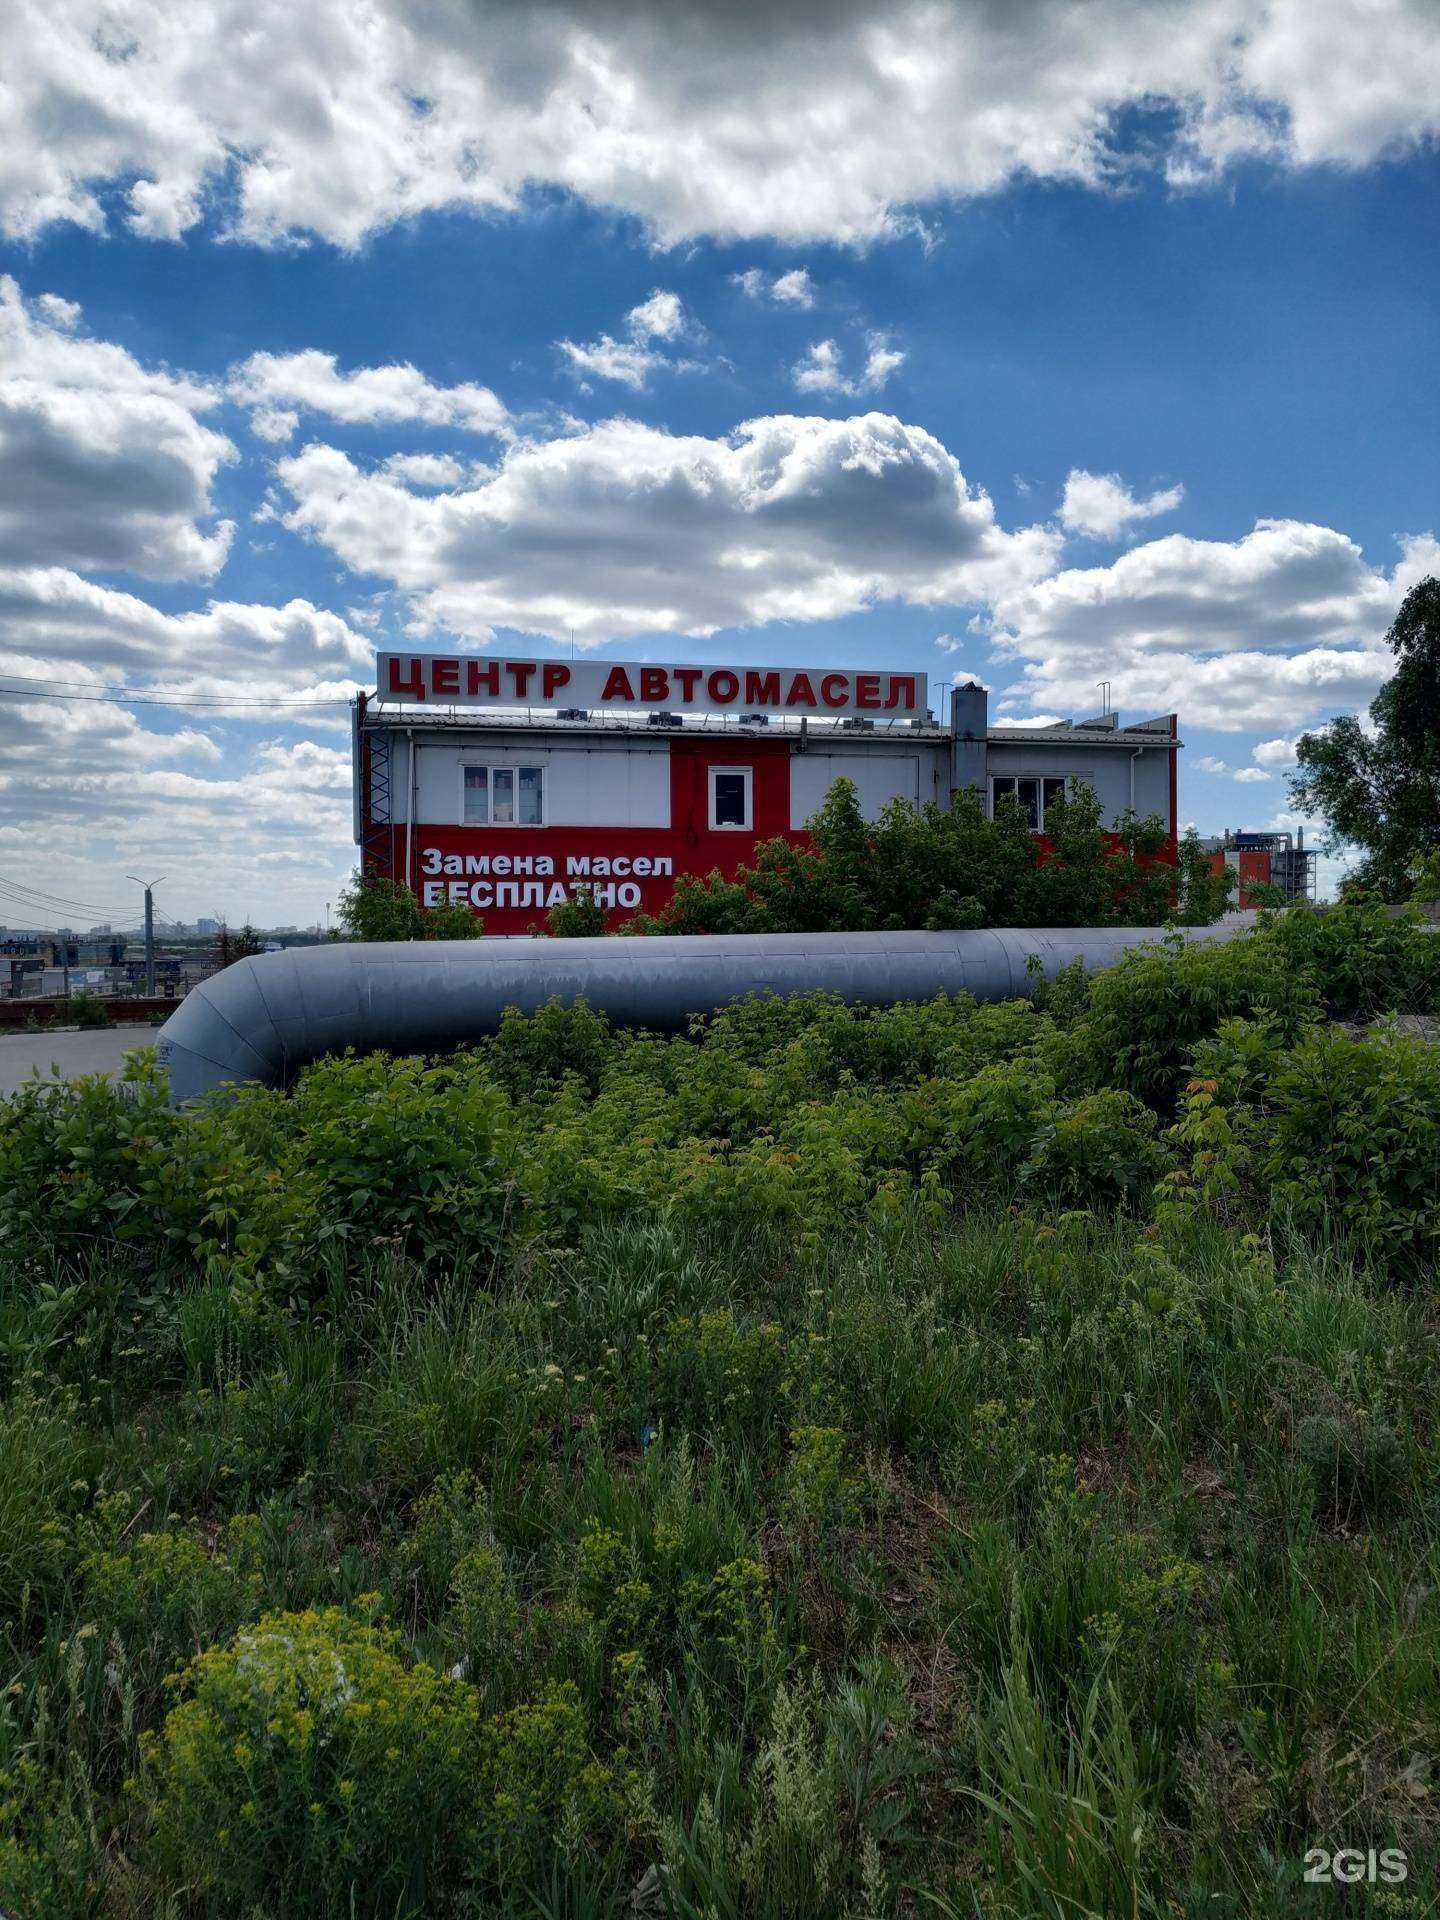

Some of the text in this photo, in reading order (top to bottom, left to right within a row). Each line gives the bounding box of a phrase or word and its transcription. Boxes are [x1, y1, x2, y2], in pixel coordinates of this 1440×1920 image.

[388, 657, 916, 709] ЦЕНТР АВТОМАСЕЛ
[422, 848, 673, 876] Замена масел
